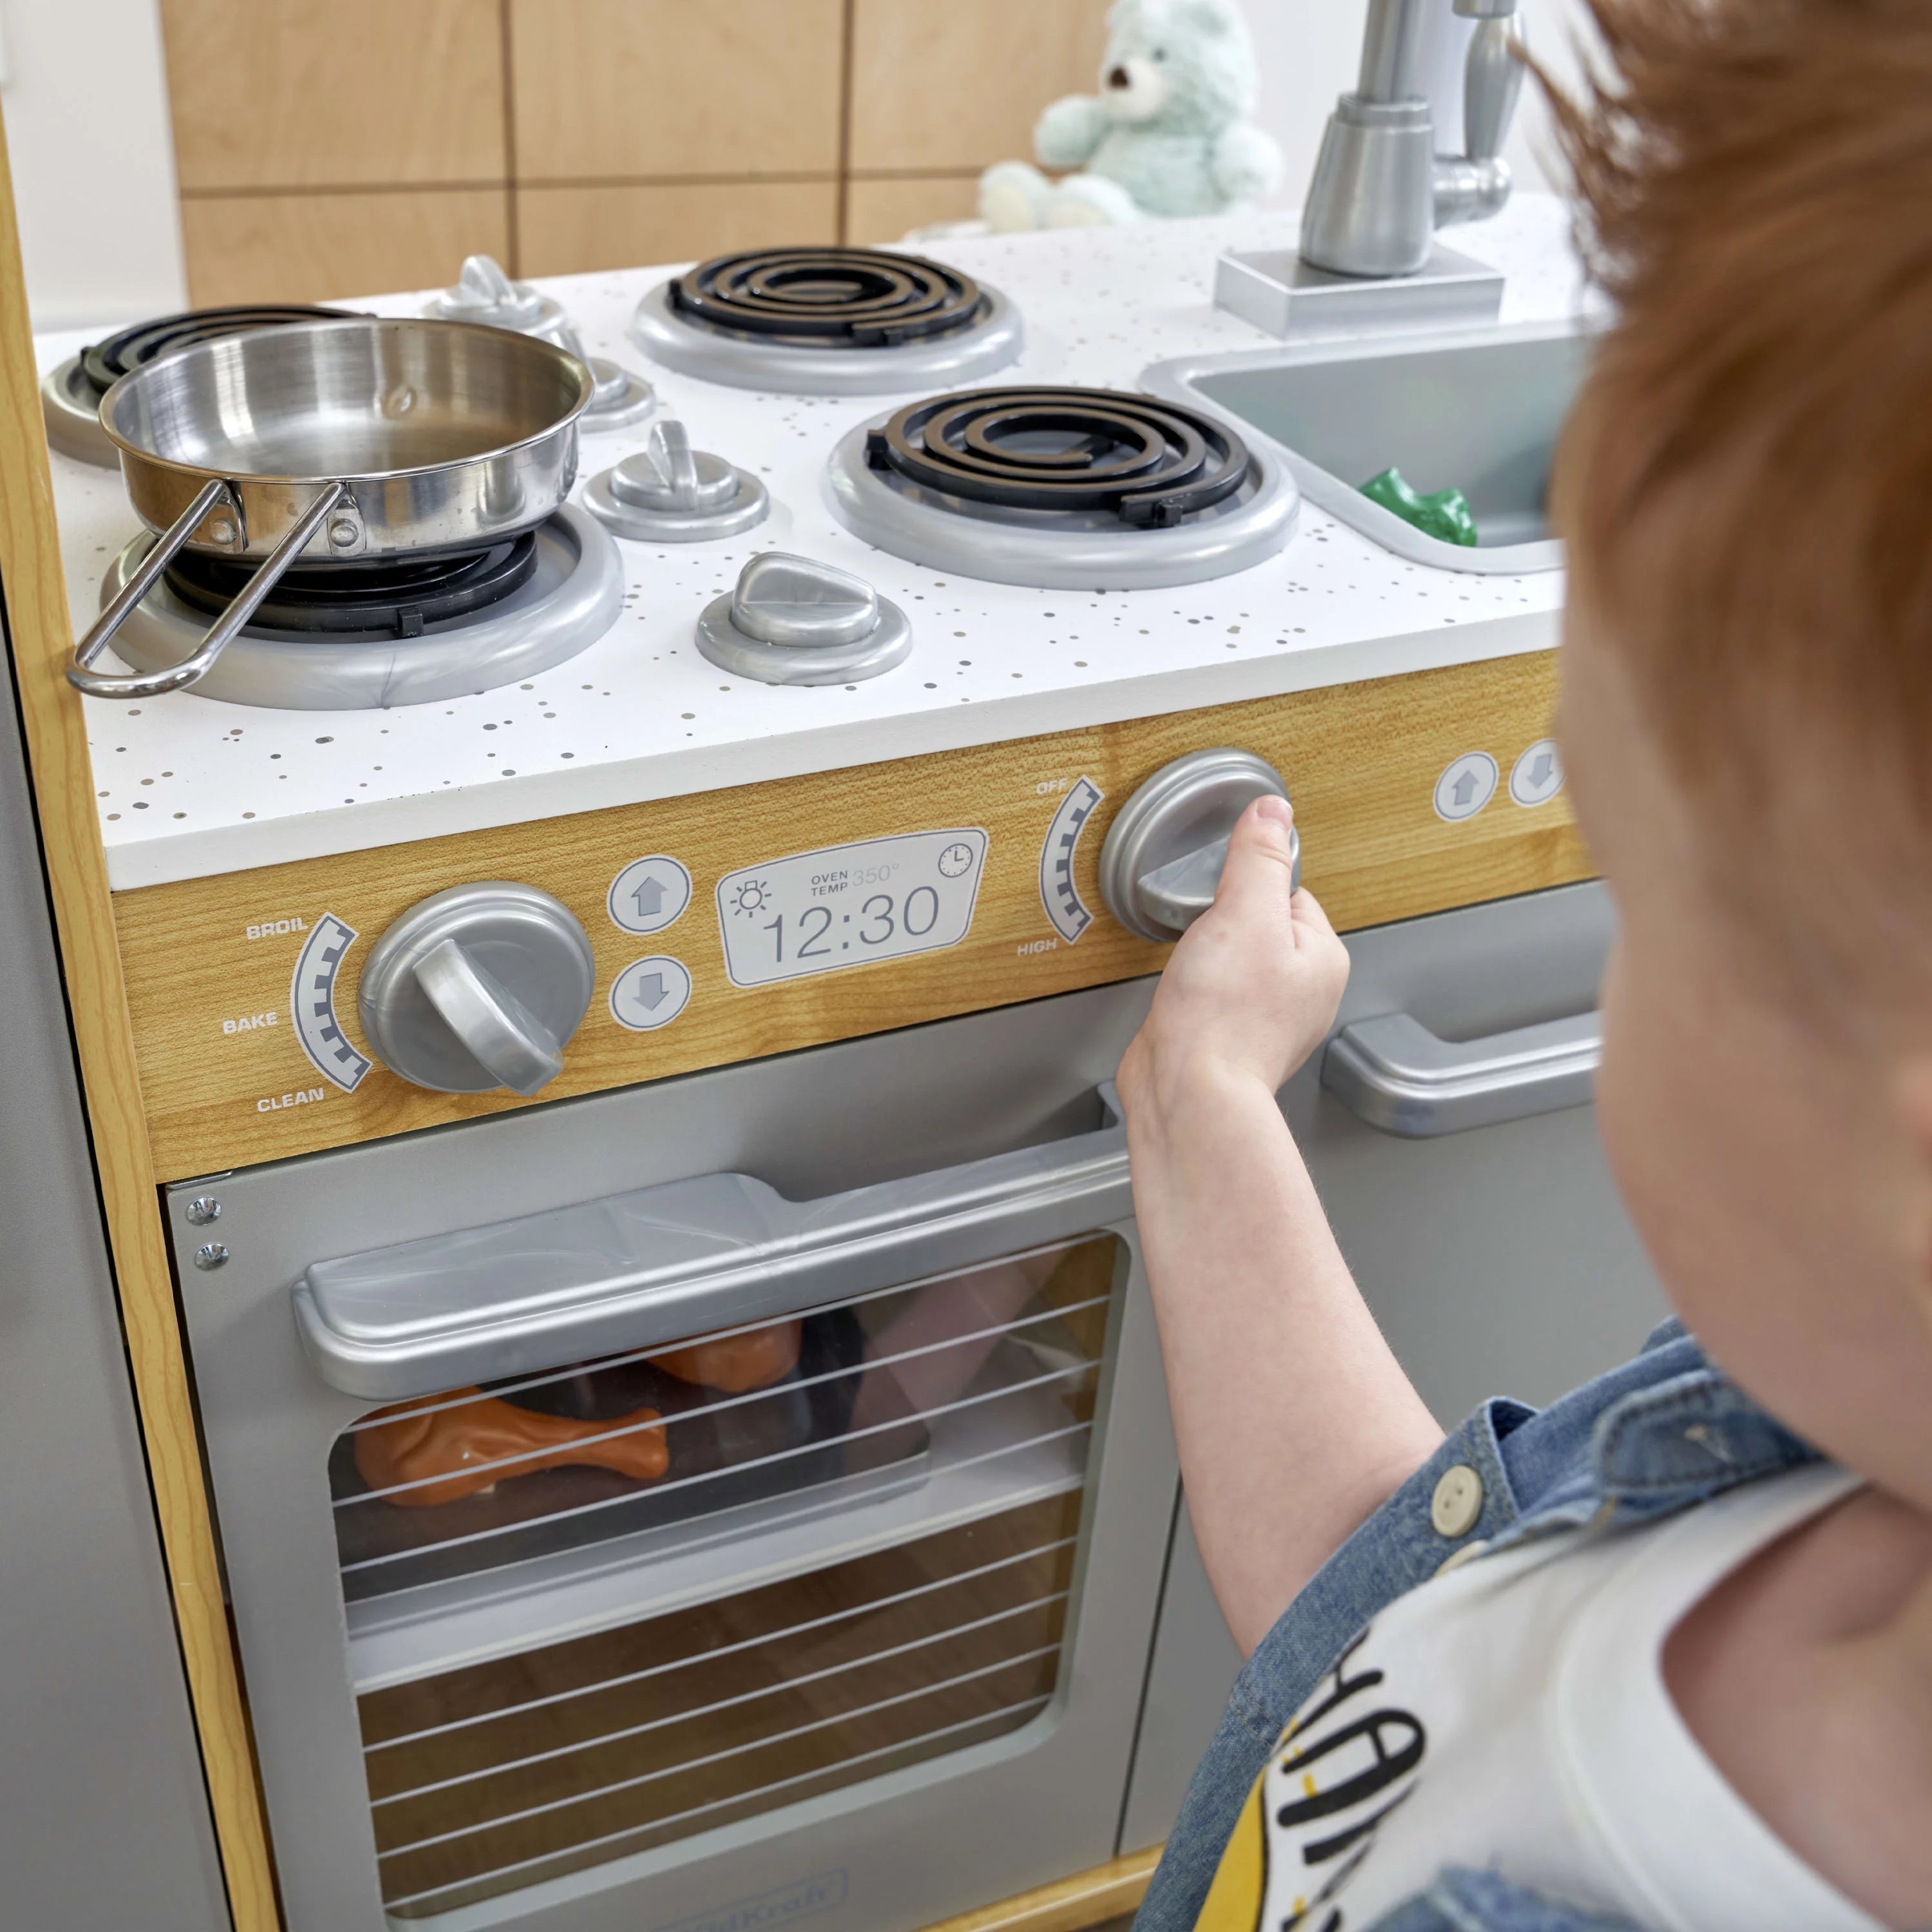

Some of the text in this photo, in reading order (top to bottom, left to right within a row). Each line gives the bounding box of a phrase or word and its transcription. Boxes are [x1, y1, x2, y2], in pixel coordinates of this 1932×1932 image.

[1036, 777, 1068, 795] OFF
[811, 870, 848, 886] OVEN
[811, 881, 848, 896] TEMP
[246, 917, 308, 940] BROIL
[763, 886, 940, 963] 12:30
[1017, 938, 1057, 957] HIGH
[222, 1012, 278, 1035] BAKE
[257, 1088, 325, 1112] CLEAN
